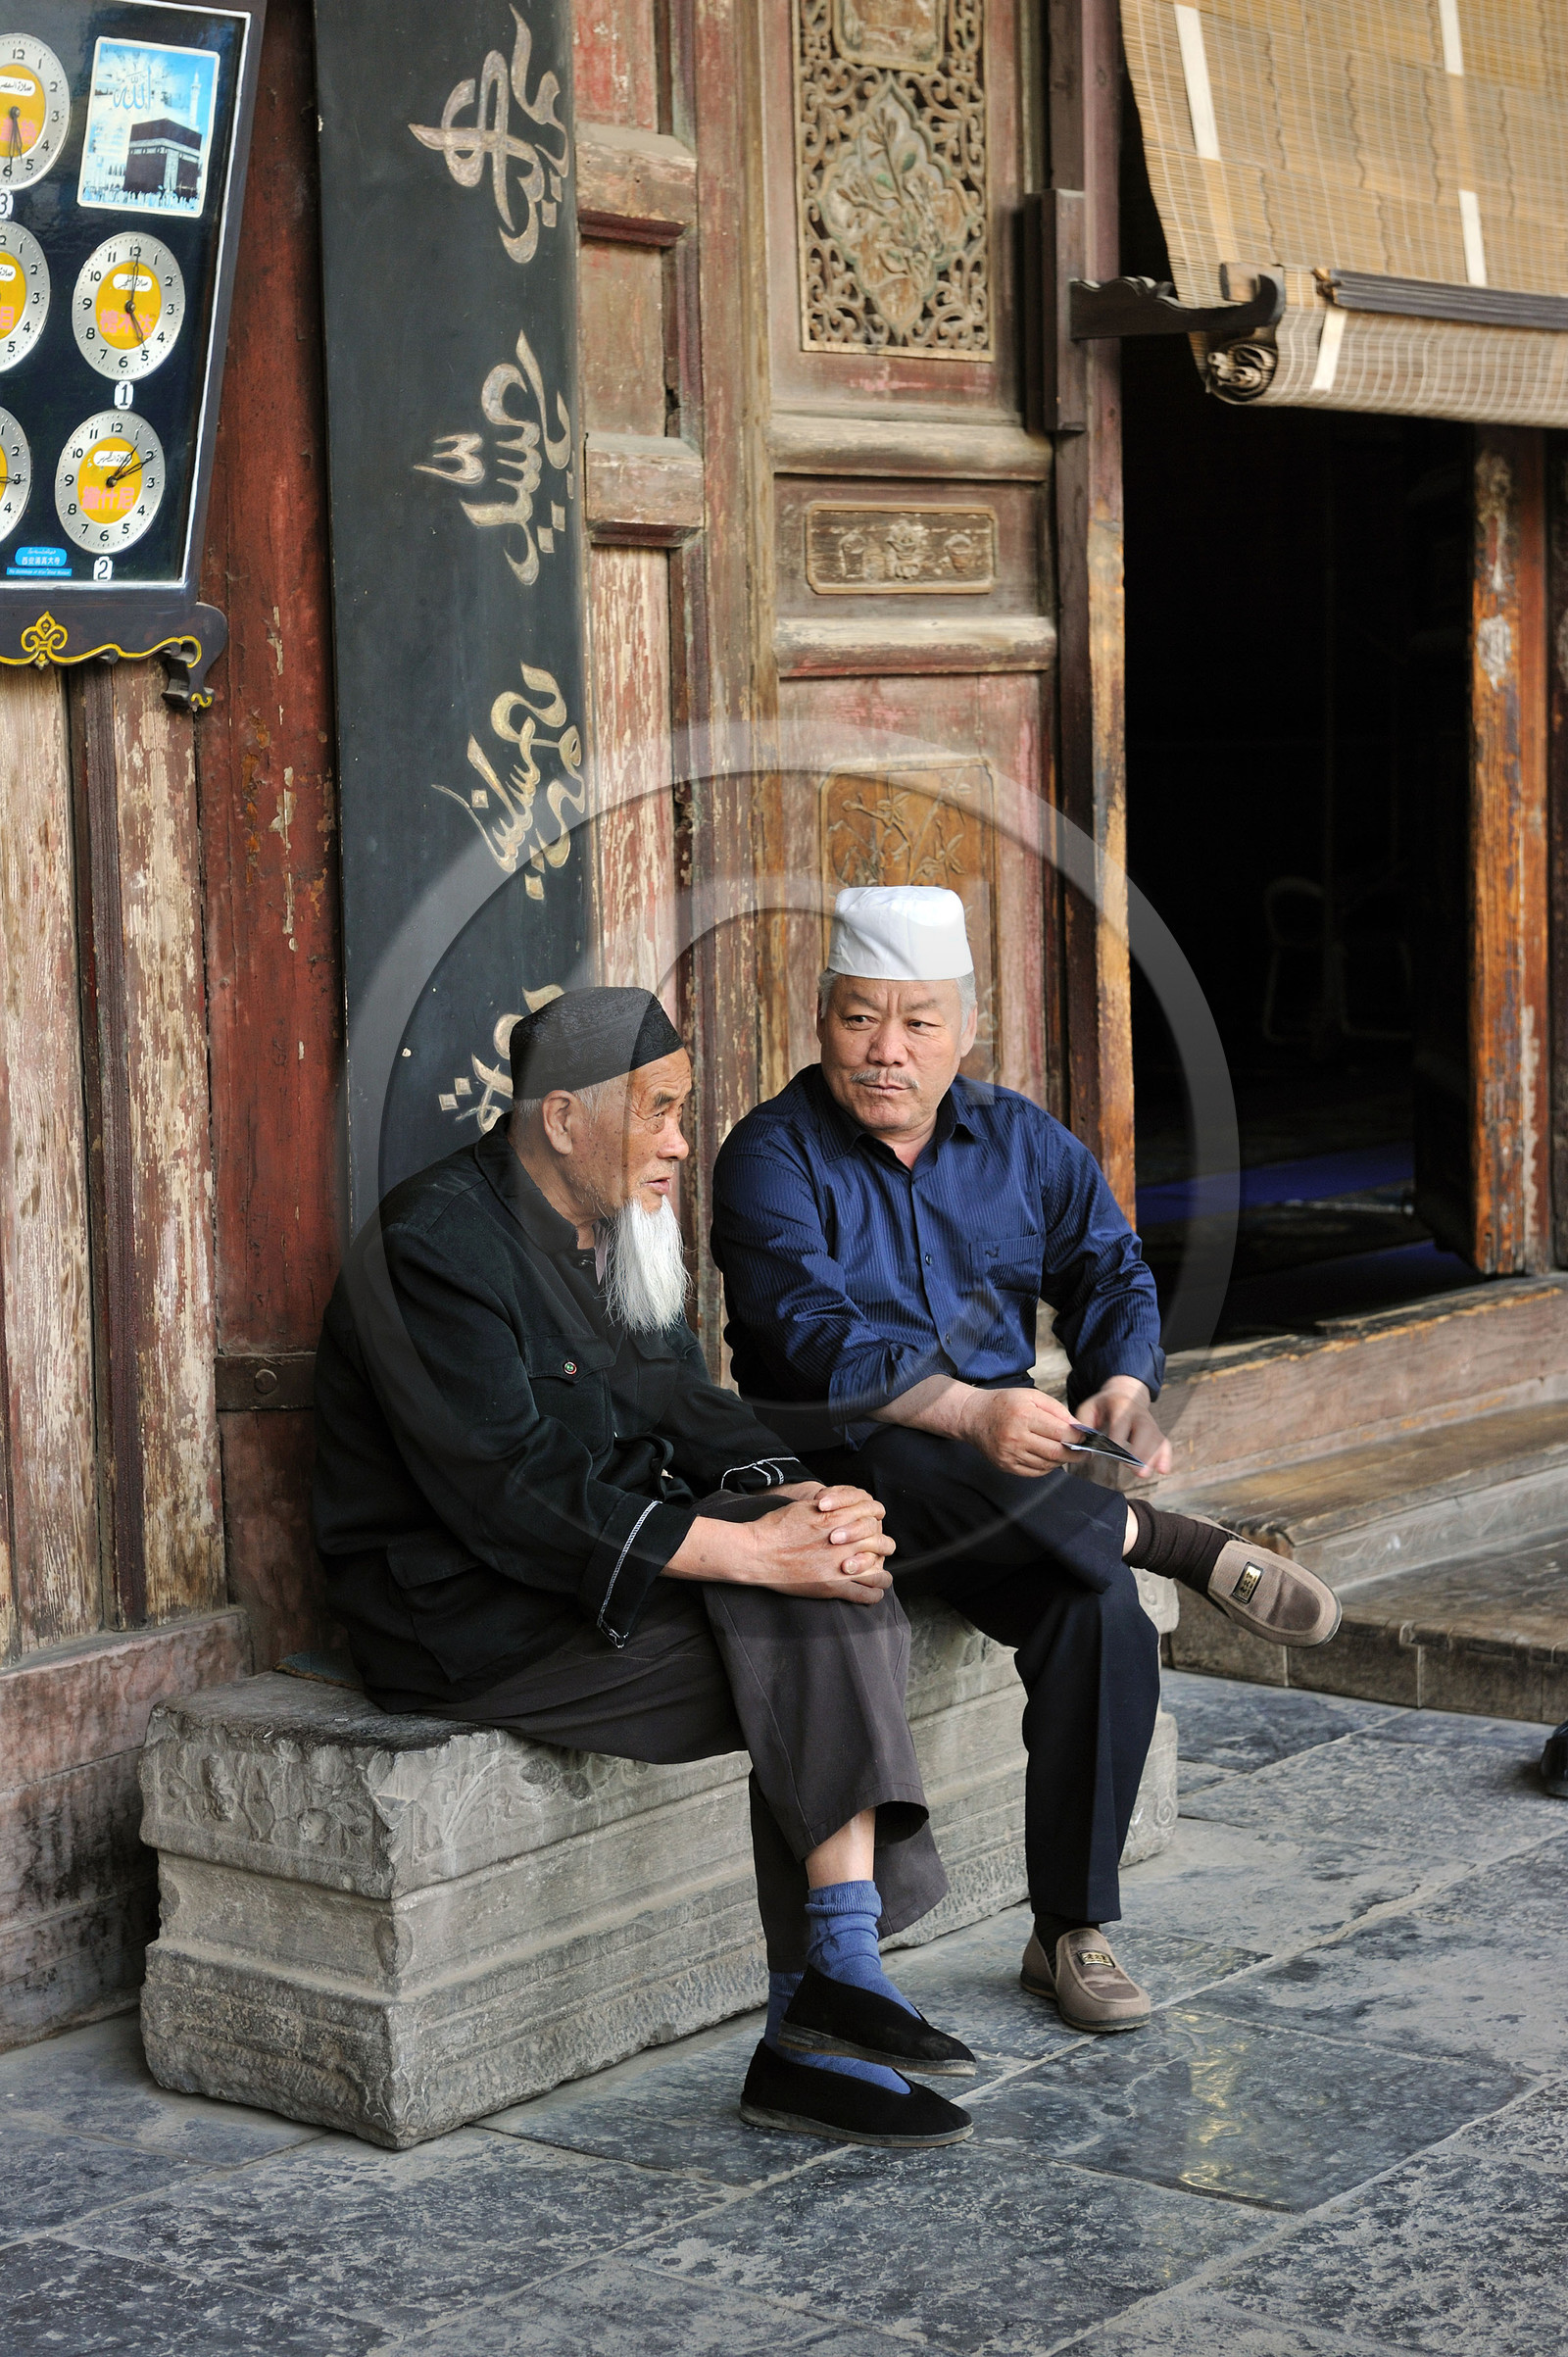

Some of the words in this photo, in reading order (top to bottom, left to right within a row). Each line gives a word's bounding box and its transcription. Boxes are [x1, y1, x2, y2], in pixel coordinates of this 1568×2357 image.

[12, 47, 25, 60] 12
[50, 81, 58, 92] 2
[51, 110, 60, 123] 3
[41, 139, 50, 151] 4
[2, 165, 13, 177] 6
[25, 159, 34, 171] 5
[128, 245, 142, 257] 12
[107, 252, 117, 263] 11
[30, 264, 38, 274] 2
[90, 270, 102, 281] 10
[165, 275, 173, 287] 2
[31, 292, 40, 304] 3
[82, 297, 92, 311] 9
[166, 303, 175, 315] 3
[23, 320, 30, 333] 4
[86, 327, 95, 340] 8
[157, 331, 165, 343] 4
[7, 341, 17, 353] 5
[100, 349, 108, 360] 7
[140, 350, 149, 362] 5
[119, 356, 128, 368] 6
[120, 383, 128, 406] 1
[111, 421, 123, 433] 12
[89, 428, 98, 439] 11
[11, 446, 20, 457] 2
[72, 448, 84, 459] 10
[64, 473, 74, 487] 9
[146, 476, 156, 488] 3
[4, 502, 12, 513] 4
[68, 503, 77, 516] 8
[137, 505, 145, 516] 4
[81, 523, 89, 534] 7
[122, 523, 130, 534] 5
[100, 529, 110, 541] 6
[97, 560, 108, 580] 2
